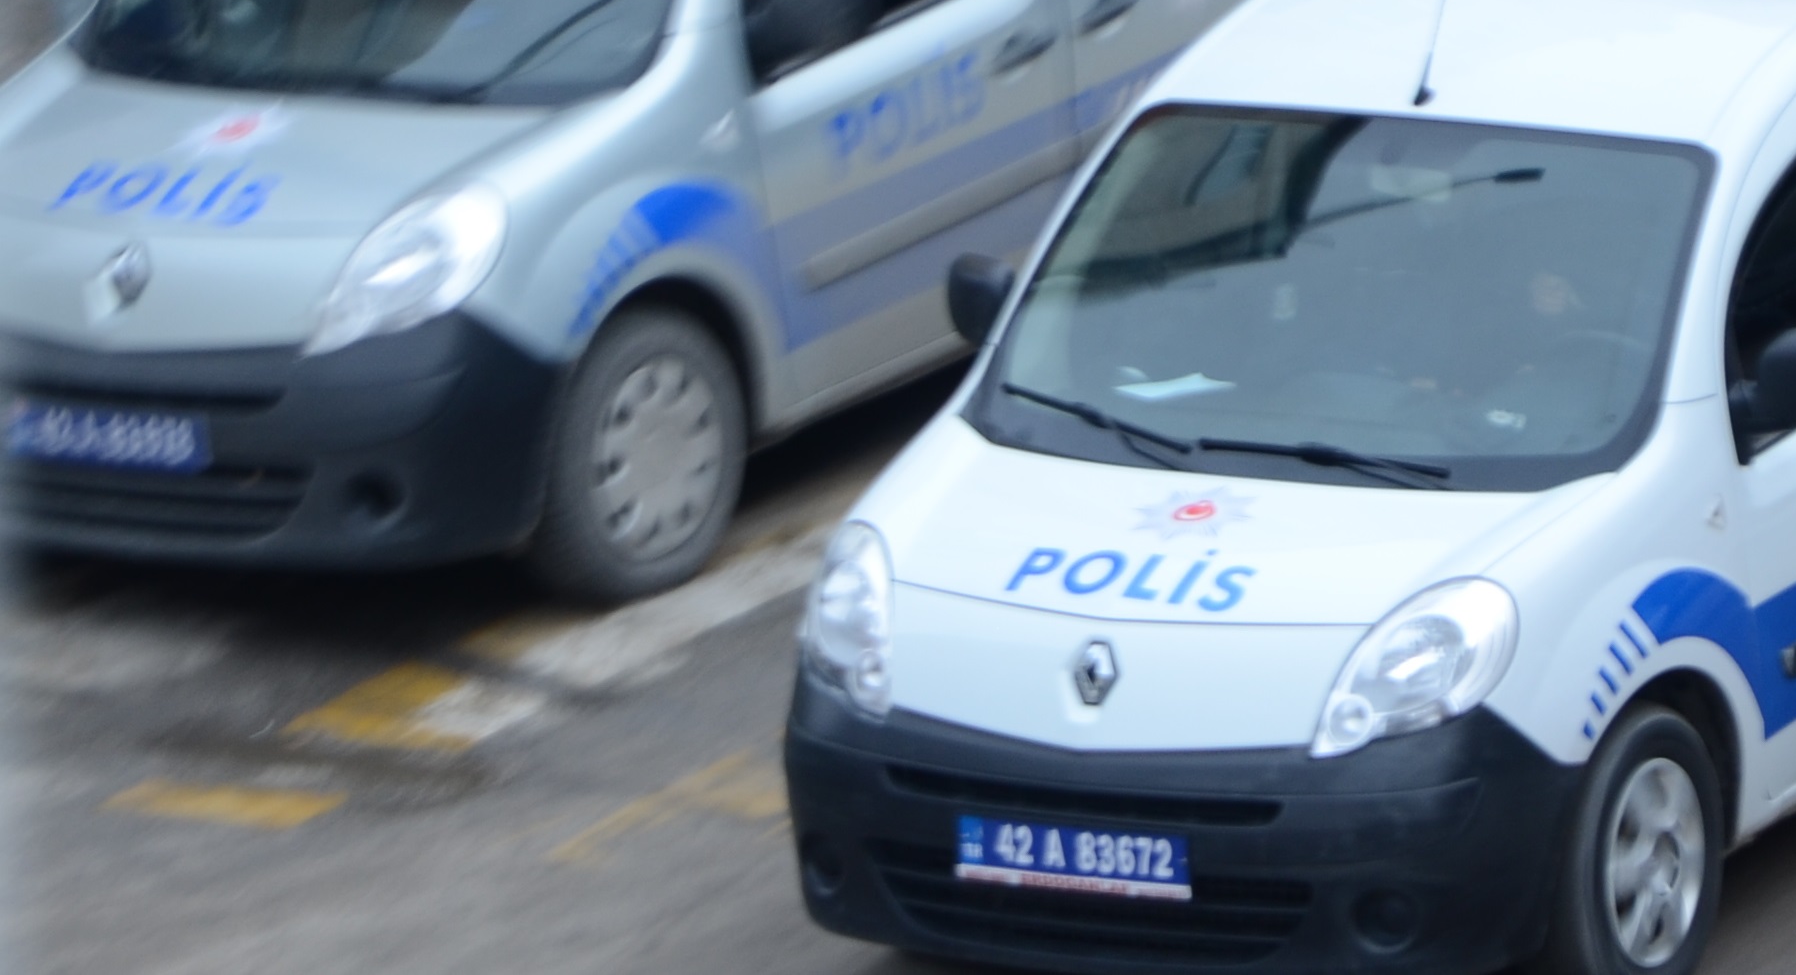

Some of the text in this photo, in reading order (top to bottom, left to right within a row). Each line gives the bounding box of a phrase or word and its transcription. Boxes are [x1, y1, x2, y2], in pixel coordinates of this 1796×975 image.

[1003, 546, 1259, 613] POLİS
[994, 823, 1175, 881] 42 A 83672
